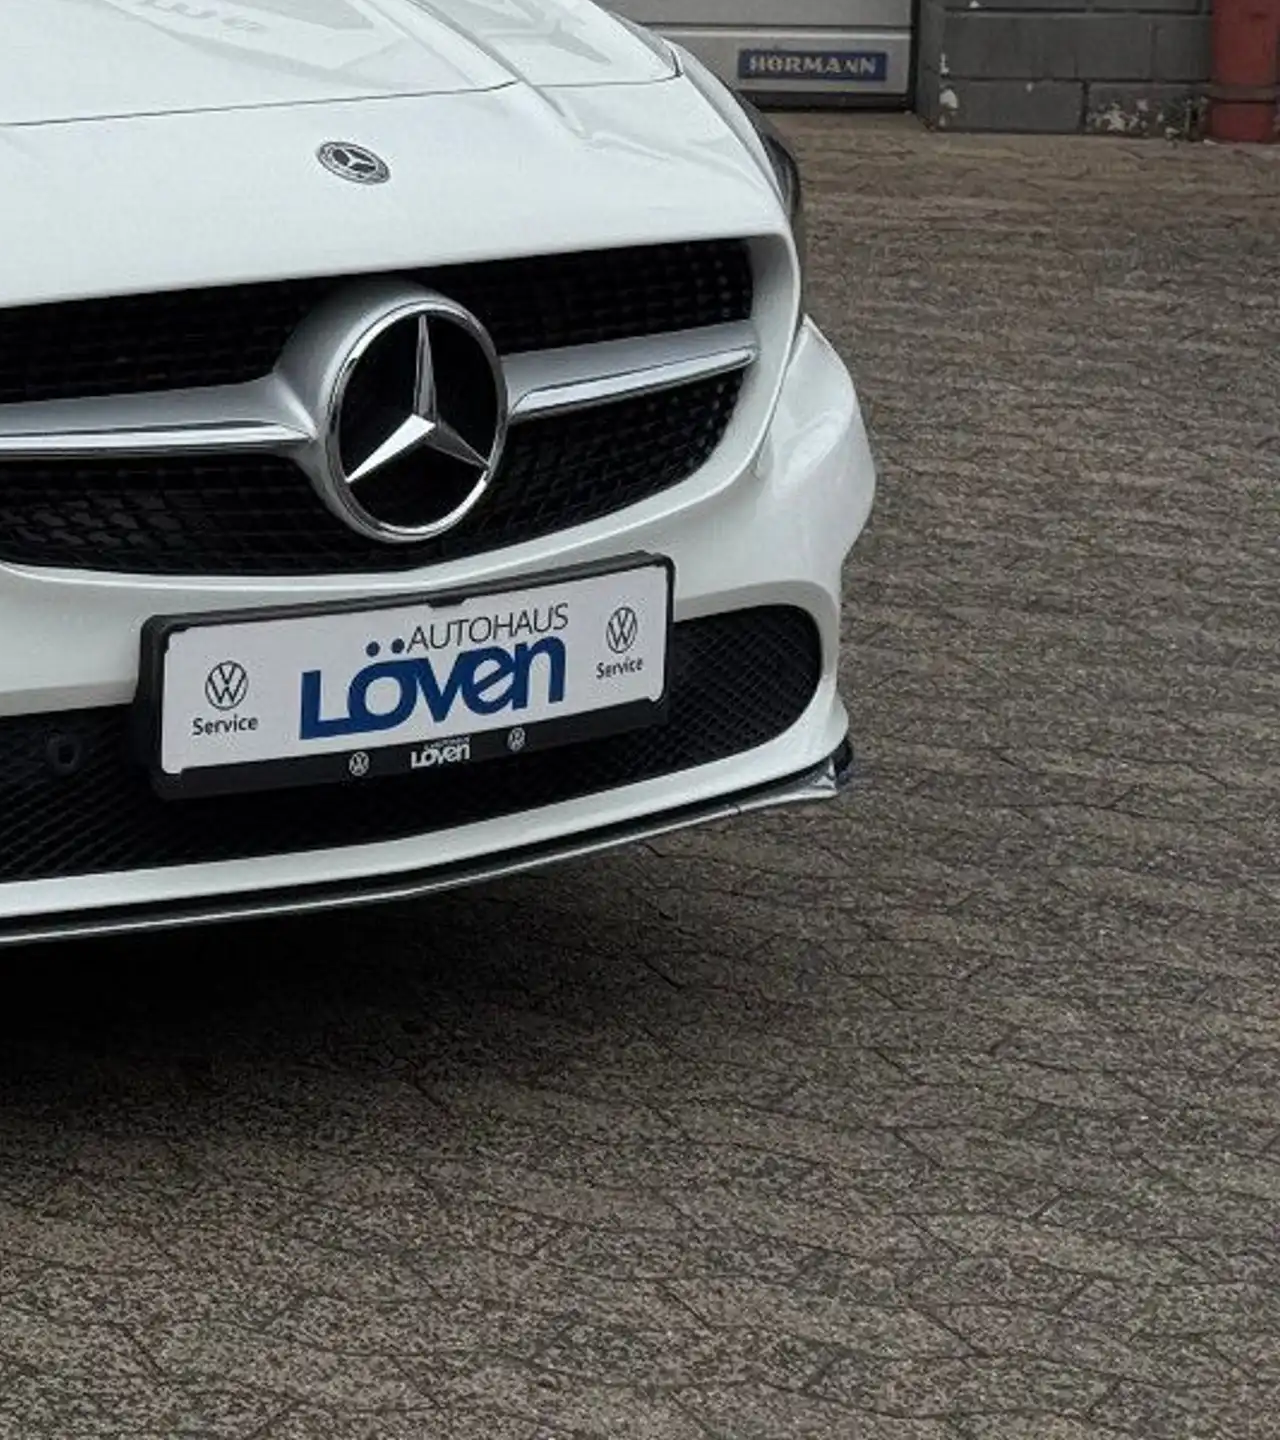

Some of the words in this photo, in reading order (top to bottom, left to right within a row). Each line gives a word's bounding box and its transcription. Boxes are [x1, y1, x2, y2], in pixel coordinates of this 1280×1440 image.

[406, 603, 569, 654] AUTOHAUS
[595, 656, 644, 679] Service
[298, 635, 567, 740] Löven
[192, 713, 259, 735] Service
